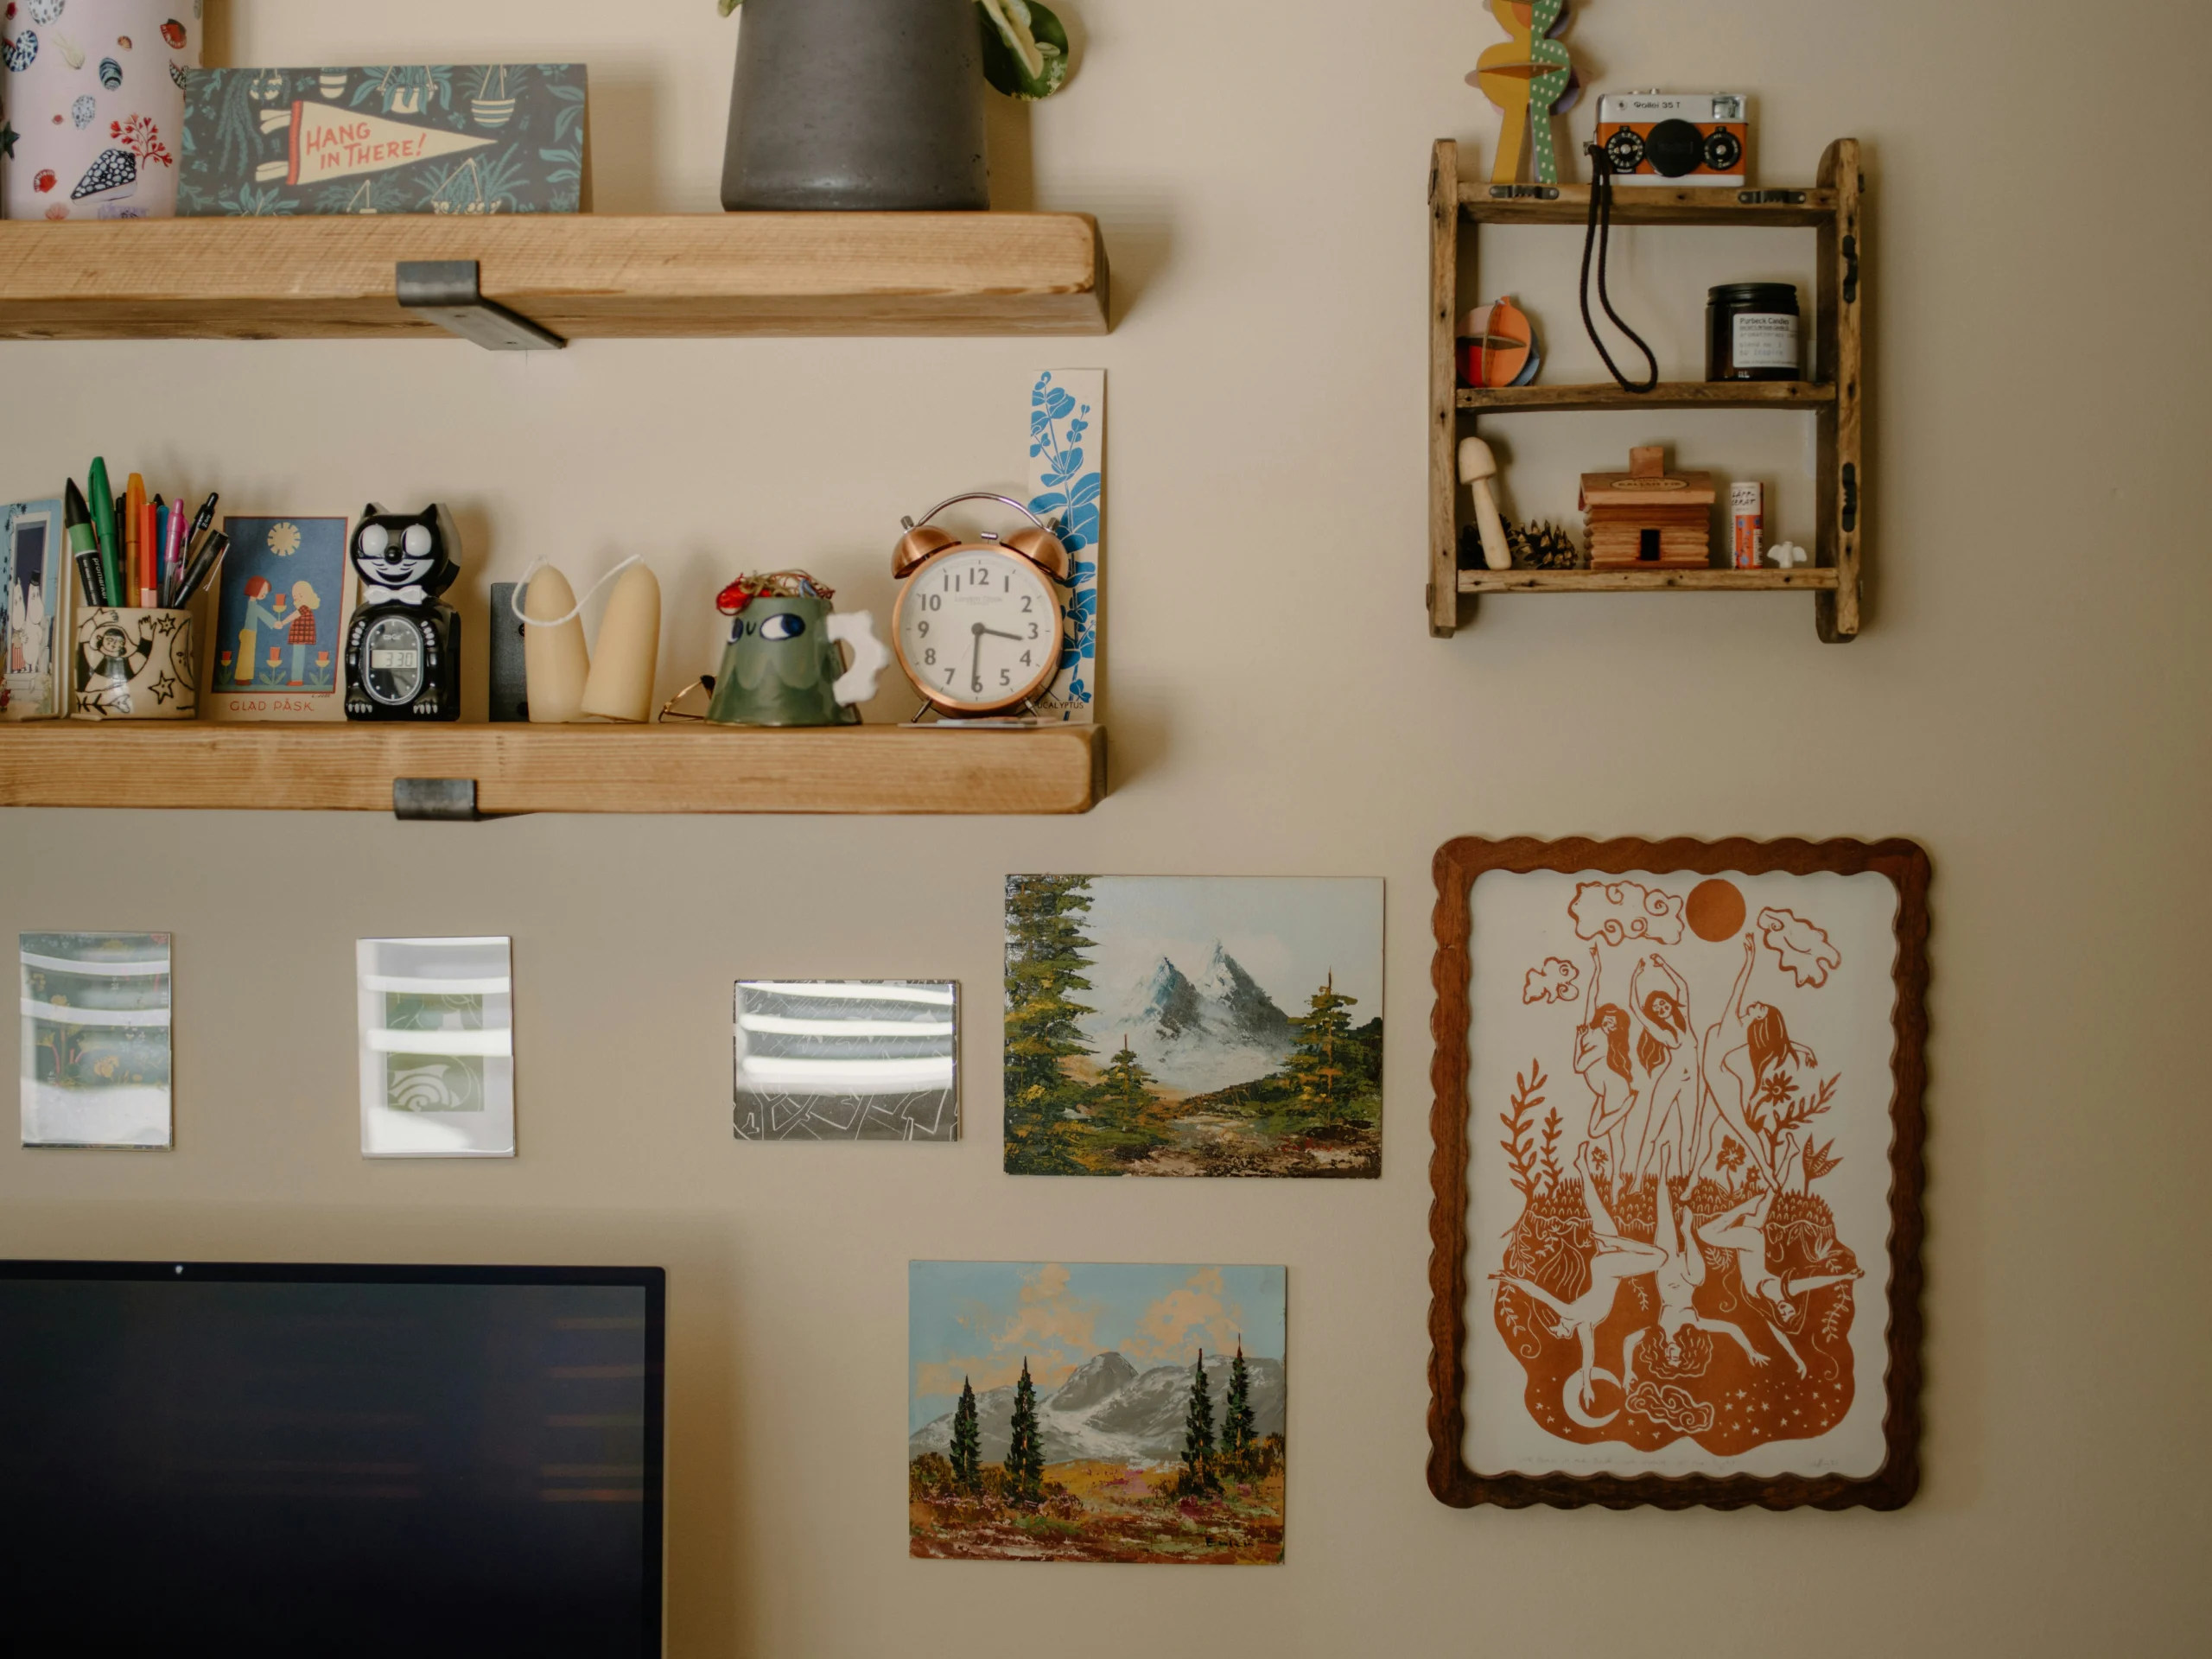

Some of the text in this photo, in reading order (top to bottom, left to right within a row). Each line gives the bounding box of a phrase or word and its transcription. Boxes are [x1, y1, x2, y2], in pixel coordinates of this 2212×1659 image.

[306, 122, 372, 156] HANG
[321, 132, 428, 170] IN THERE!
[944, 574, 960, 592] 11
[969, 567, 989, 585] 12
[1004, 575, 1009, 593] 1
[920, 594, 941, 611] 10
[1020, 595, 1033, 613] 2
[918, 620, 930, 639] 9
[1028, 622, 1039, 639] 3
[924, 648, 937, 665] 8
[1020, 650, 1031, 666] 4
[944, 668, 956, 685] 7
[971, 675, 983, 693] 6
[999, 669, 1010, 686] 5
[229, 697, 315, 711] GLAD PÅSK
